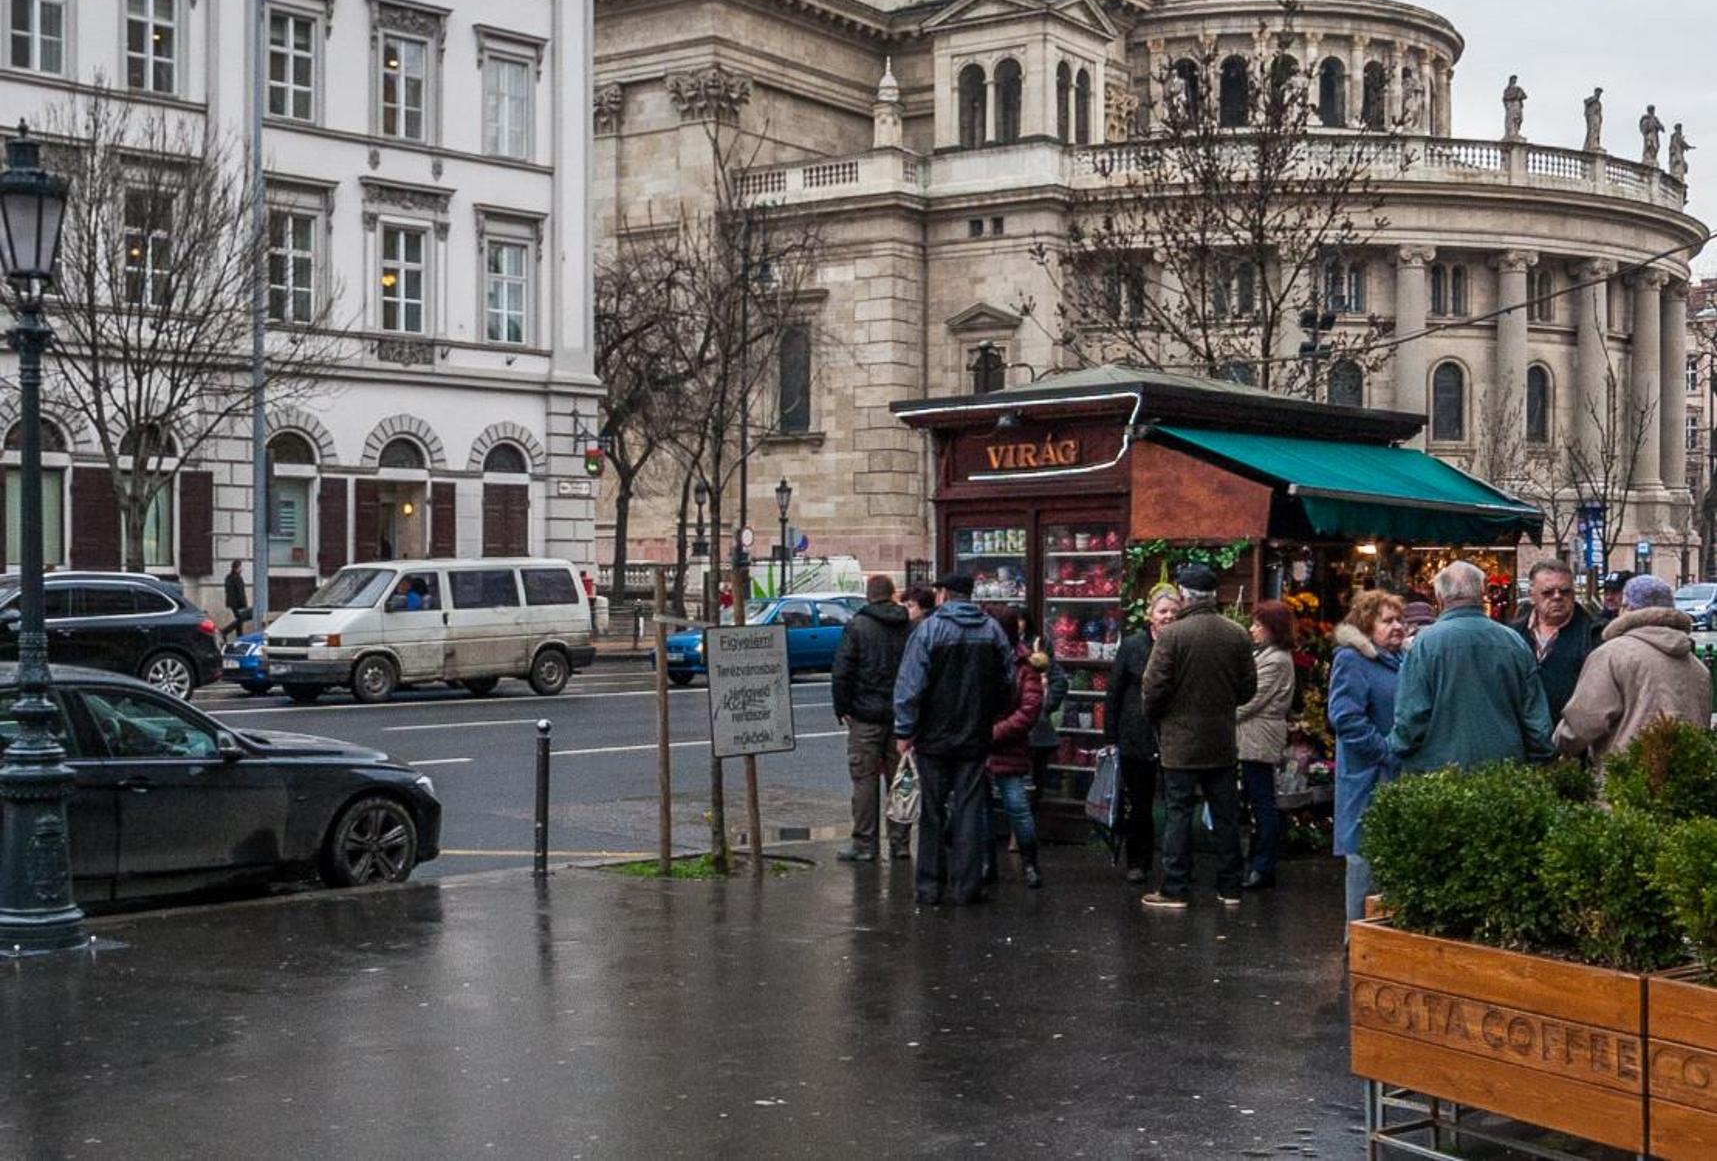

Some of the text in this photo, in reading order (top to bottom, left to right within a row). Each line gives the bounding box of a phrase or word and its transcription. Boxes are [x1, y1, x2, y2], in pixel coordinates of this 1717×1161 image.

[986, 432, 1080, 469] VIRÁG
[1352, 980, 1639, 1081] COSTA COFFEE
